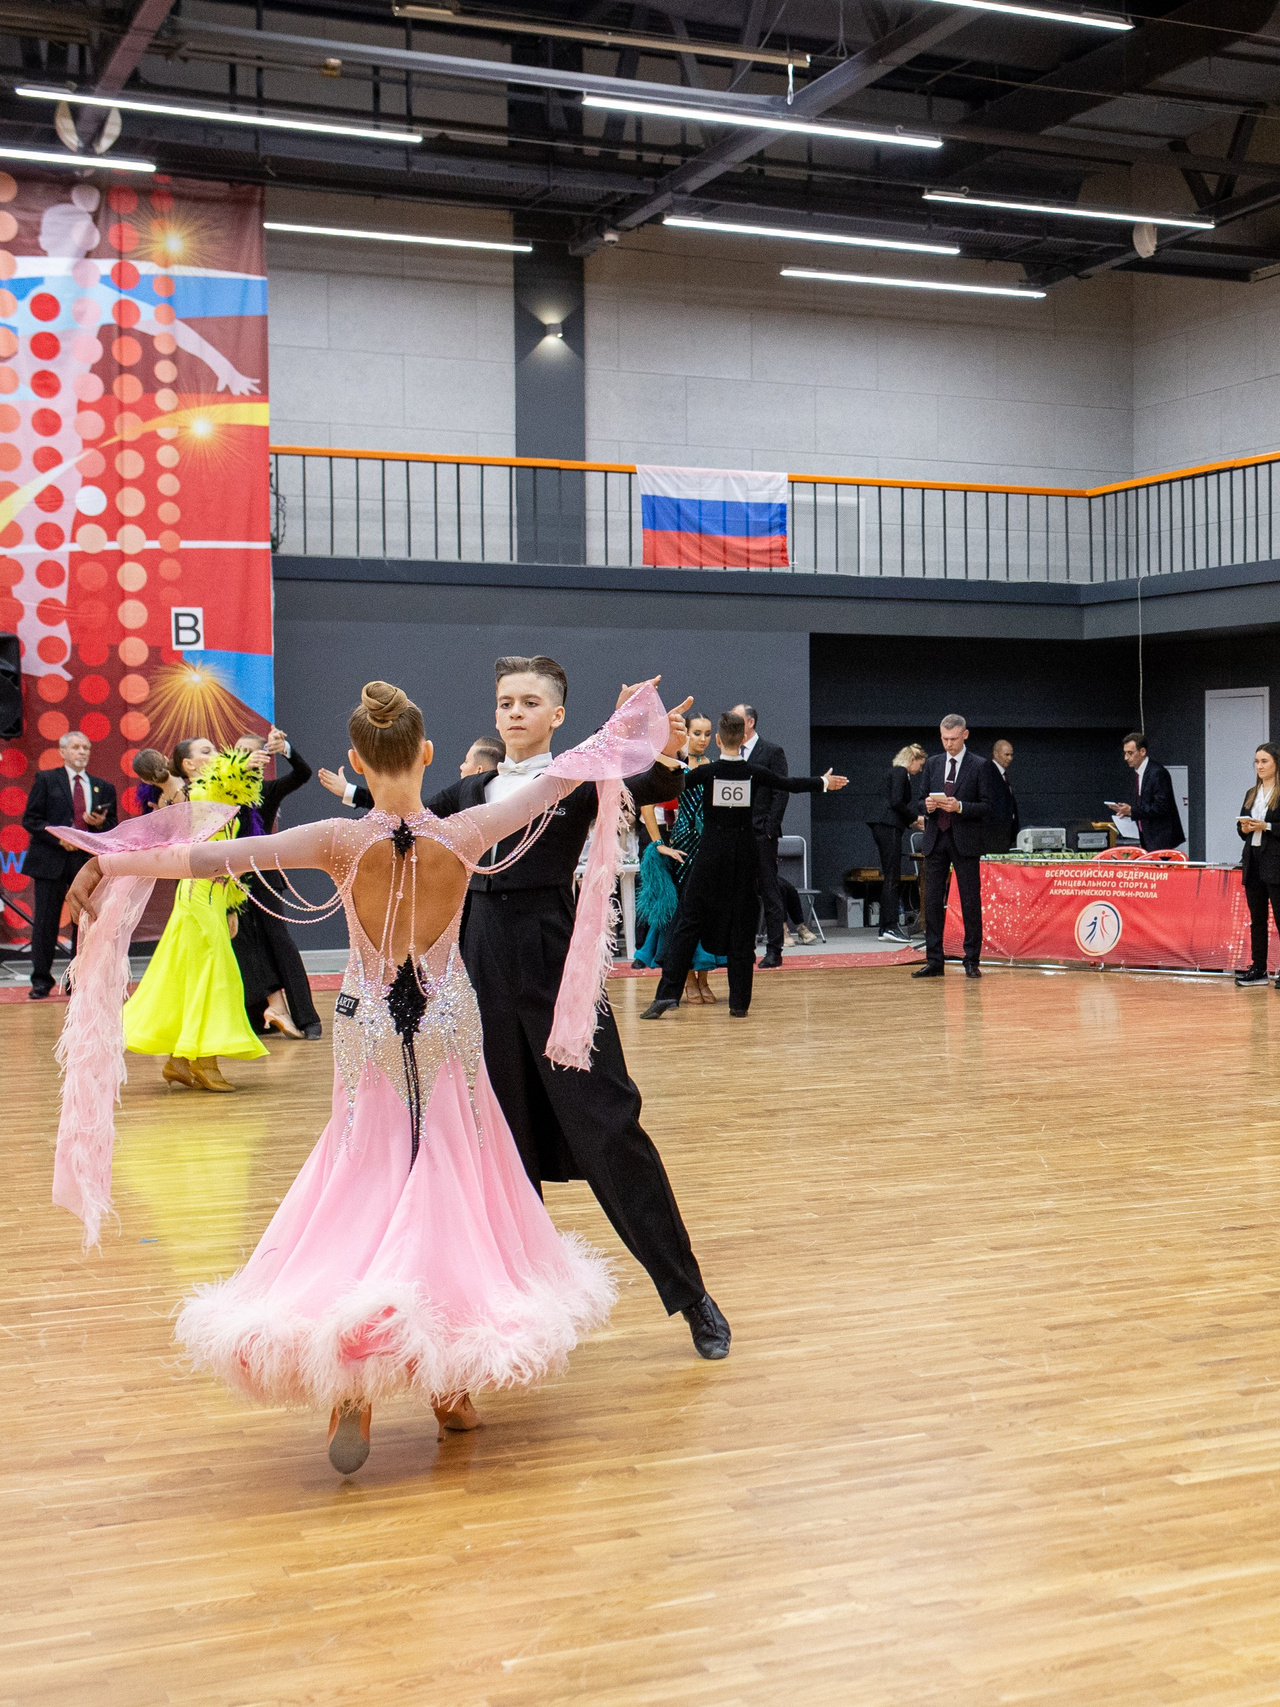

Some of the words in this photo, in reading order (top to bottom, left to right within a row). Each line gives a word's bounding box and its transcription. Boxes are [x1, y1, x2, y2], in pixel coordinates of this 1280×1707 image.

[721, 786, 743, 801] 66
[1045, 869, 1114, 878] ВСЕРОССИЙСКАЯ
[1116, 870, 1168, 881] ФЕДЕРАЦИЯ
[1053, 880, 1116, 888] ТАНЦЕВАЛЬНОГО
[1118, 881, 1148, 889] СПОРТА
[1049, 888, 1111, 897] АКРОБАТИЧЕСКОГО
